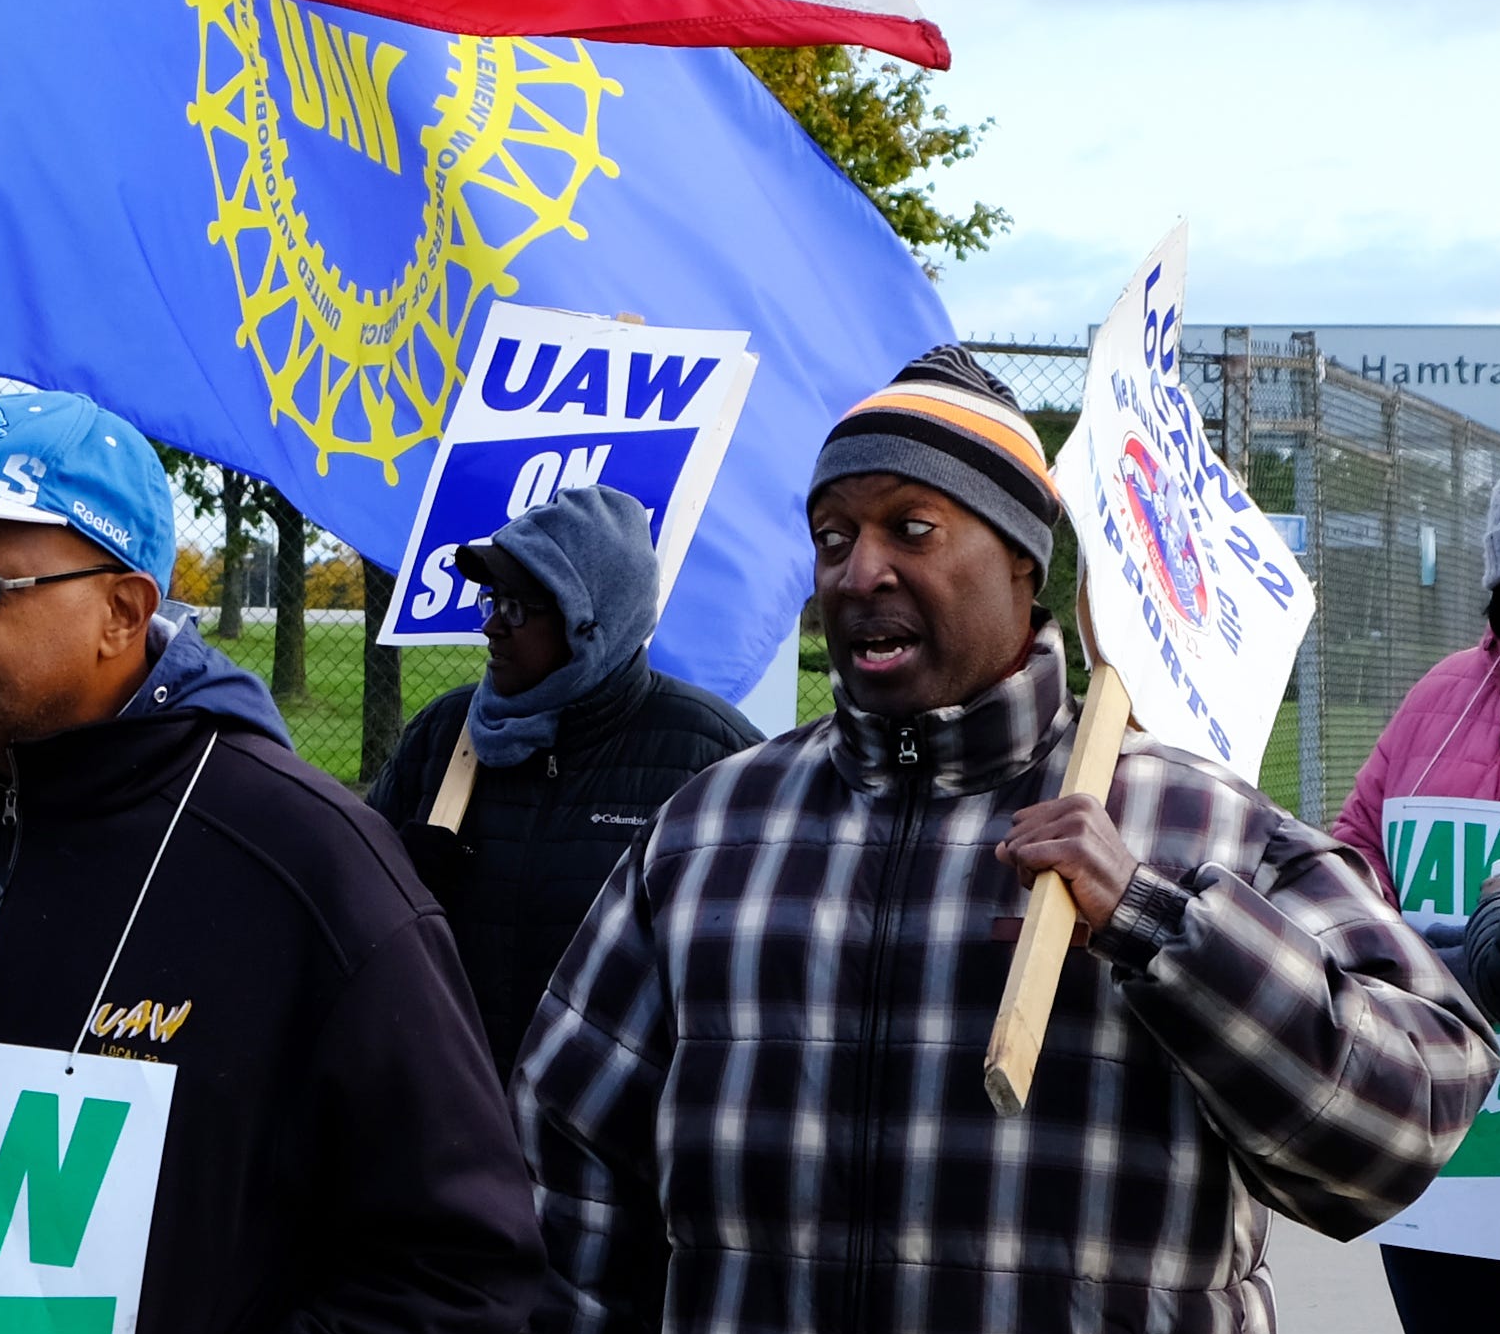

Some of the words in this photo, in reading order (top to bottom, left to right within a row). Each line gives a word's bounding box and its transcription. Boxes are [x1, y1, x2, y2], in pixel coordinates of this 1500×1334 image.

[298, 255, 343, 332] UNITED
[411, 271, 429, 308] OF
[481, 336, 721, 422] UAW
[1143, 261, 1213, 522] LOCAL
[1225, 525, 1295, 611] 22
[72, 500, 132, 551] Reebok
[1111, 369, 1130, 412] We
[1215, 586, 1243, 656] City
[89, 999, 193, 1044] UAW
